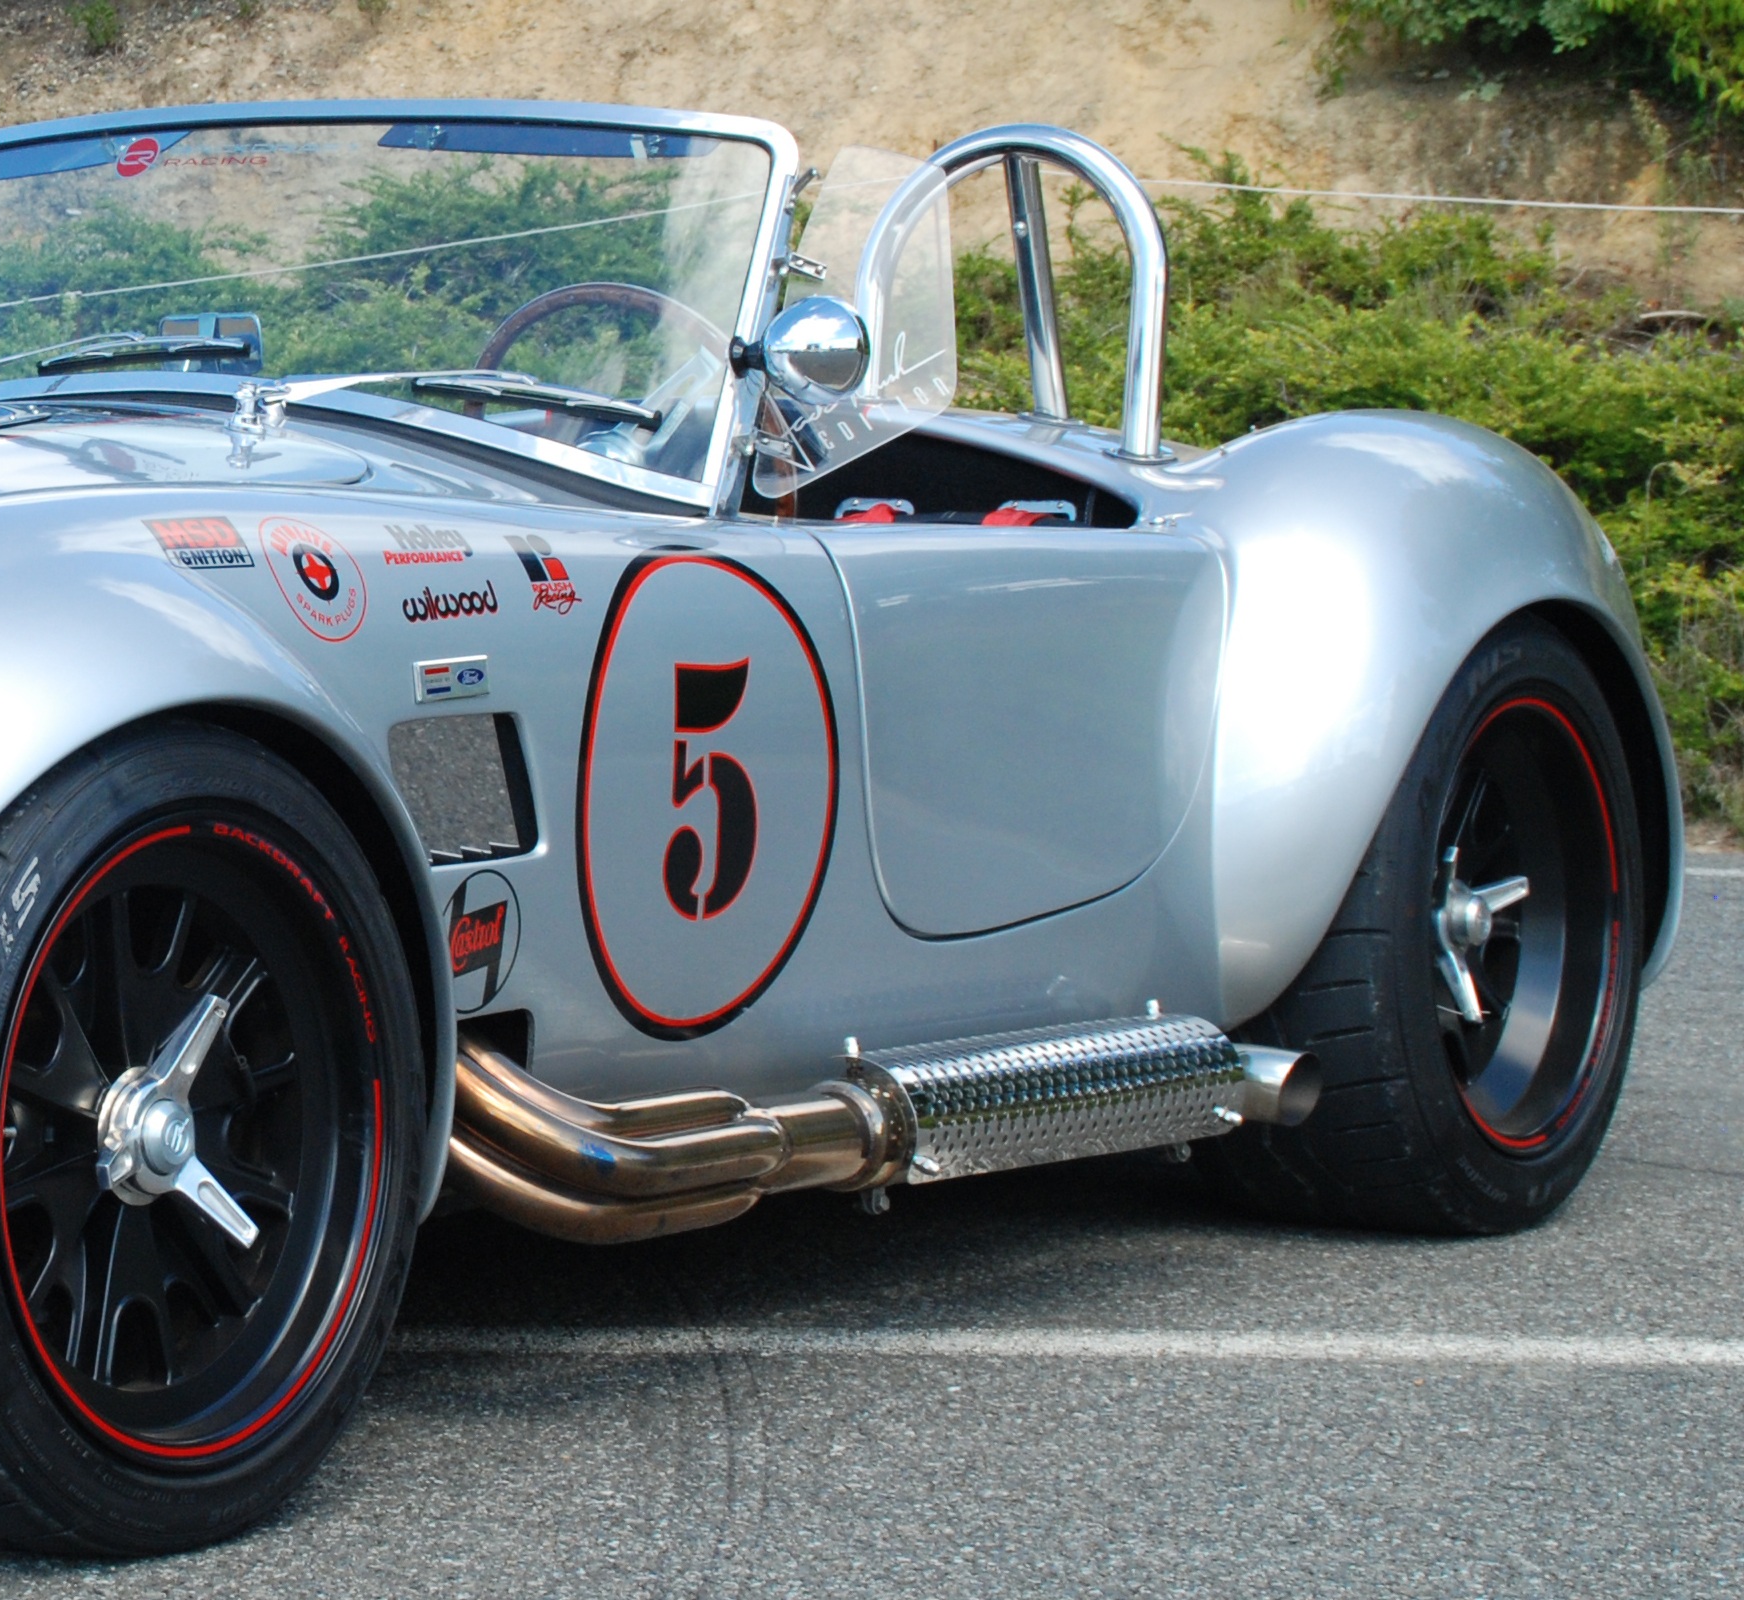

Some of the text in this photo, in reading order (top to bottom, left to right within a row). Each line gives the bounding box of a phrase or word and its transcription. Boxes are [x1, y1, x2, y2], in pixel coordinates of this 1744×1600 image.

[163, 156, 268, 167] RACING
[151, 518, 239, 549] MSD
[383, 525, 474, 558] Holley
[173, 548, 246, 567] IGNITION
[383, 550, 464, 565] PERFORMANCE
[402, 579, 498, 622] wilwood
[531, 581, 574, 593] ROUSH
[296, 587, 357, 626] SPARK PLUGS
[662, 656, 758, 921] 5
[212, 822, 337, 921] BACKDRAFT
[339, 935, 377, 1044] RACING
[450, 904, 506, 972] Castrol
